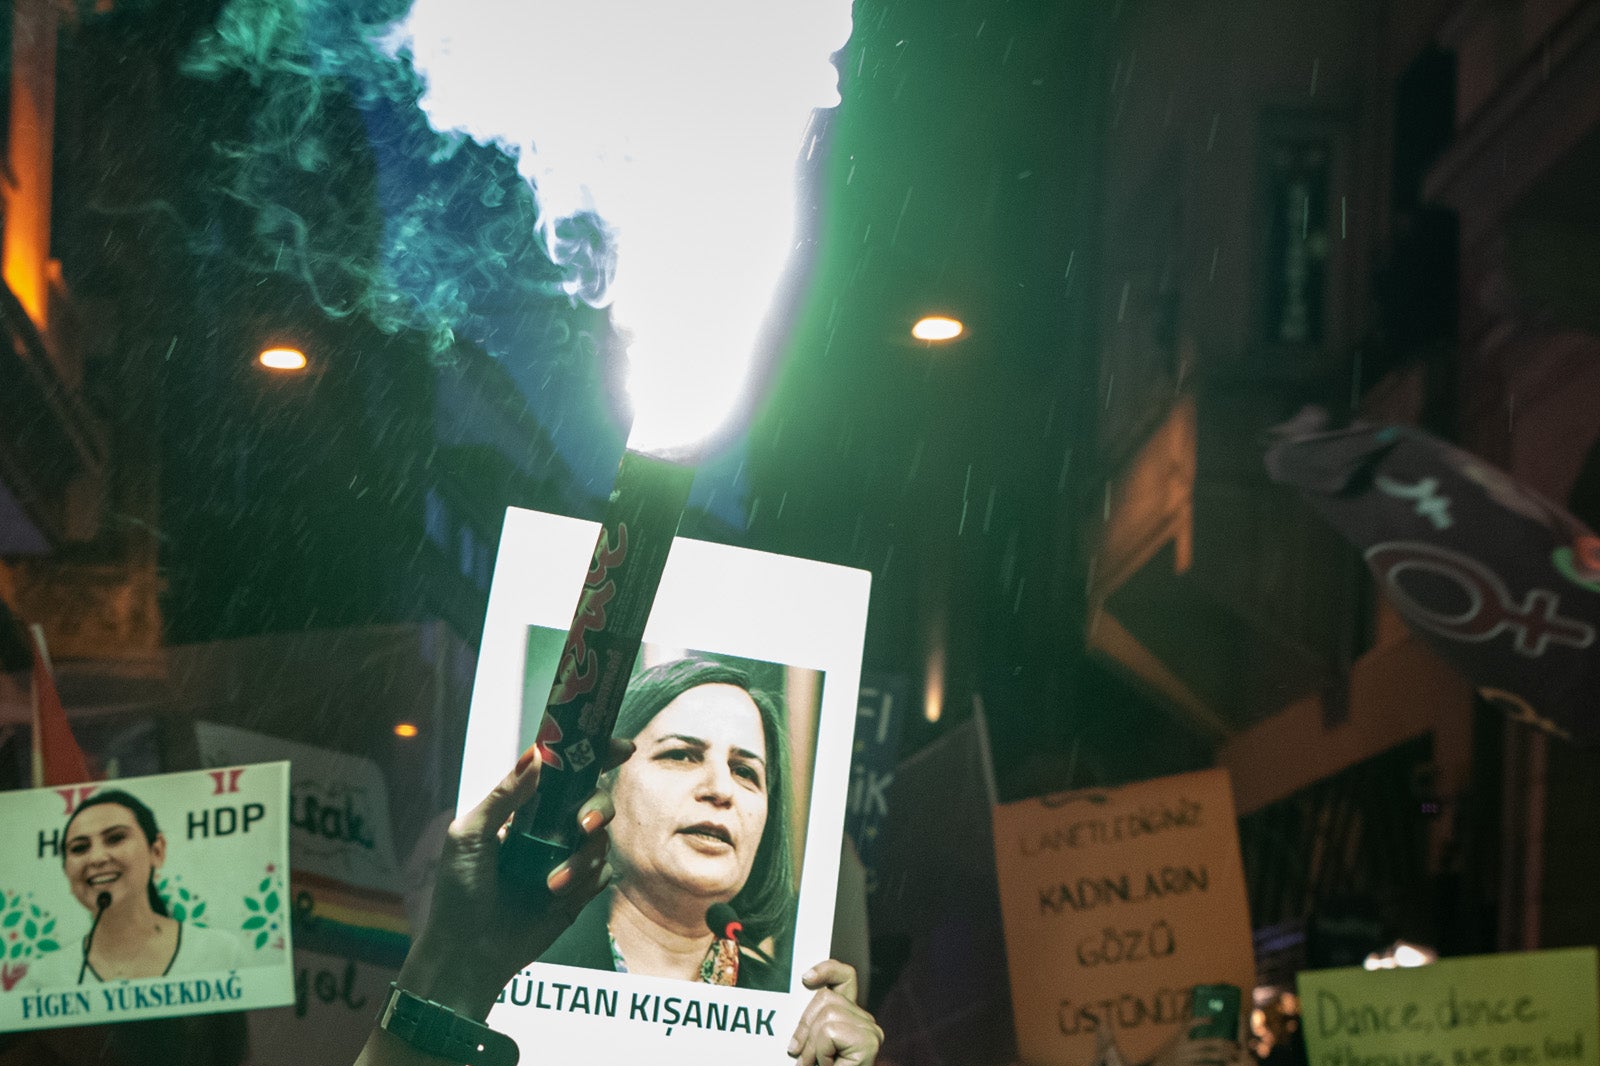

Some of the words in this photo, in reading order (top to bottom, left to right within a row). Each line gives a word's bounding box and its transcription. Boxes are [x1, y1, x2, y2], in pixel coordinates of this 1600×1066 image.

[187, 803, 266, 840] HDP
[1037, 865, 1209, 915] KADINLARIN
[1076, 918, 1176, 967] GÖZÜ
[21, 988, 90, 1019] FİGEN
[102, 969, 243, 1012] YÜKSEKDAĞ
[629, 992, 777, 1036] KIŞANAK
